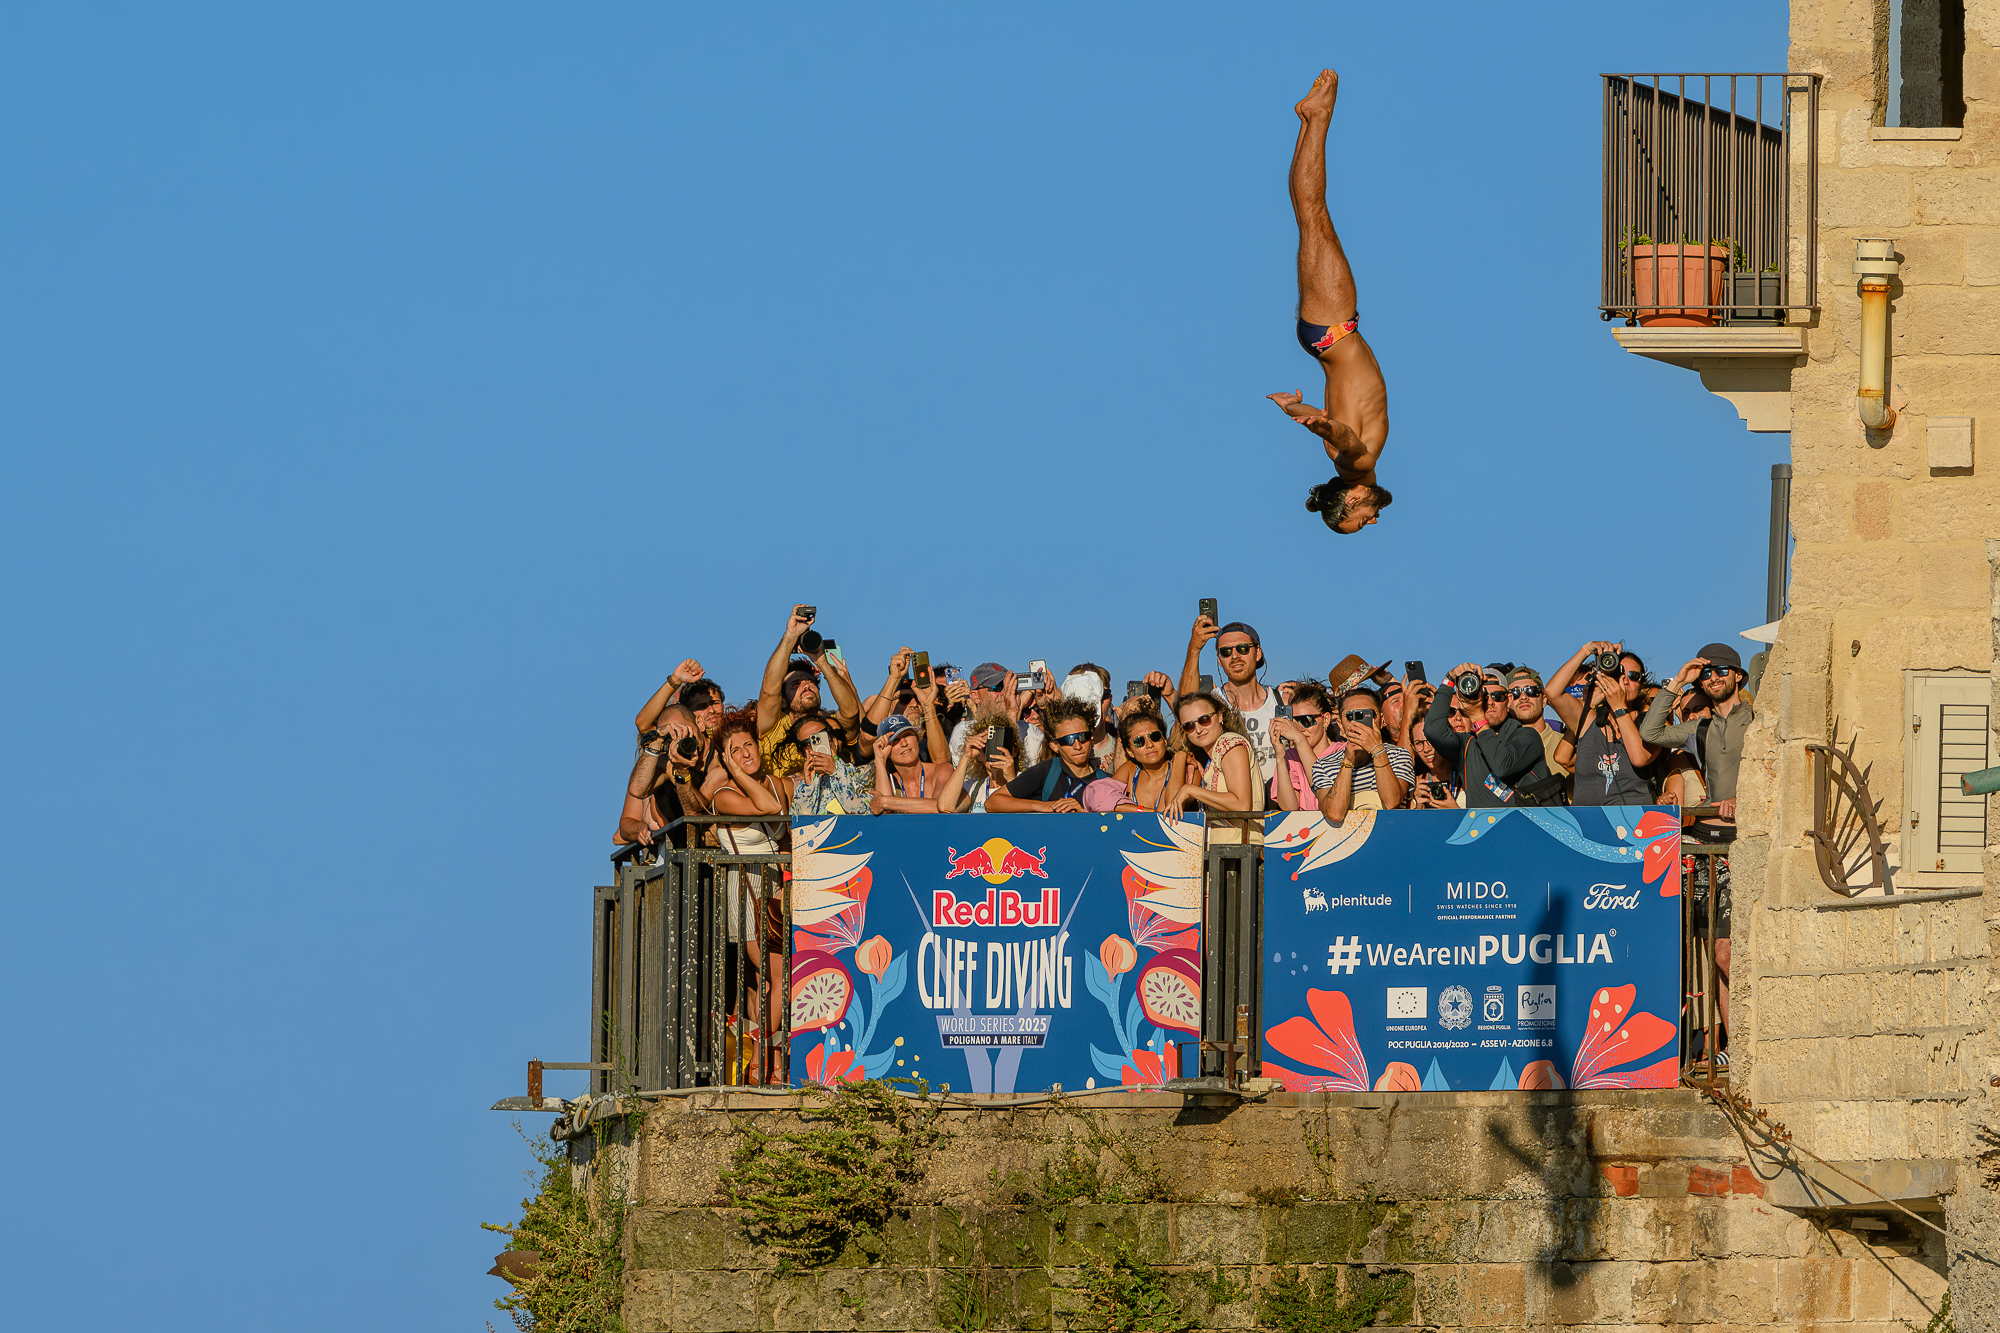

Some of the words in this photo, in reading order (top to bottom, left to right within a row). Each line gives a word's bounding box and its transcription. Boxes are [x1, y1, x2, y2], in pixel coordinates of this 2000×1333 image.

[1331, 893, 1392, 909] plenitude
[1583, 883, 1641, 910] Ford
[933, 888, 997, 927] Red
[999, 888, 1060, 927] Bull
[917, 931, 978, 1009] CLIFF
[986, 930, 1073, 1009] DIVING
[1521, 991, 1552, 1015] Puglia
[941, 1017, 976, 1032] WORLD
[980, 1017, 1015, 1032] SERIES
[1018, 1017, 1047, 1032] 2025
[949, 1036, 991, 1045] POLIGNANO
[993, 1036, 999, 1045] A
[1000, 1036, 1021, 1045] MARE
[1022, 1036, 1038, 1045] ITALY
[1388, 1041, 1404, 1049] POC
[1405, 1040, 1432, 1049] PUGLIA
[1433, 1040, 1469, 1050] 2014/2020
[1480, 1039, 1498, 1047] ASSE
[1499, 1039, 1507, 1047] VI
[1512, 1039, 1540, 1047] AZIONE
[1541, 1039, 1553, 1047] 6.8
